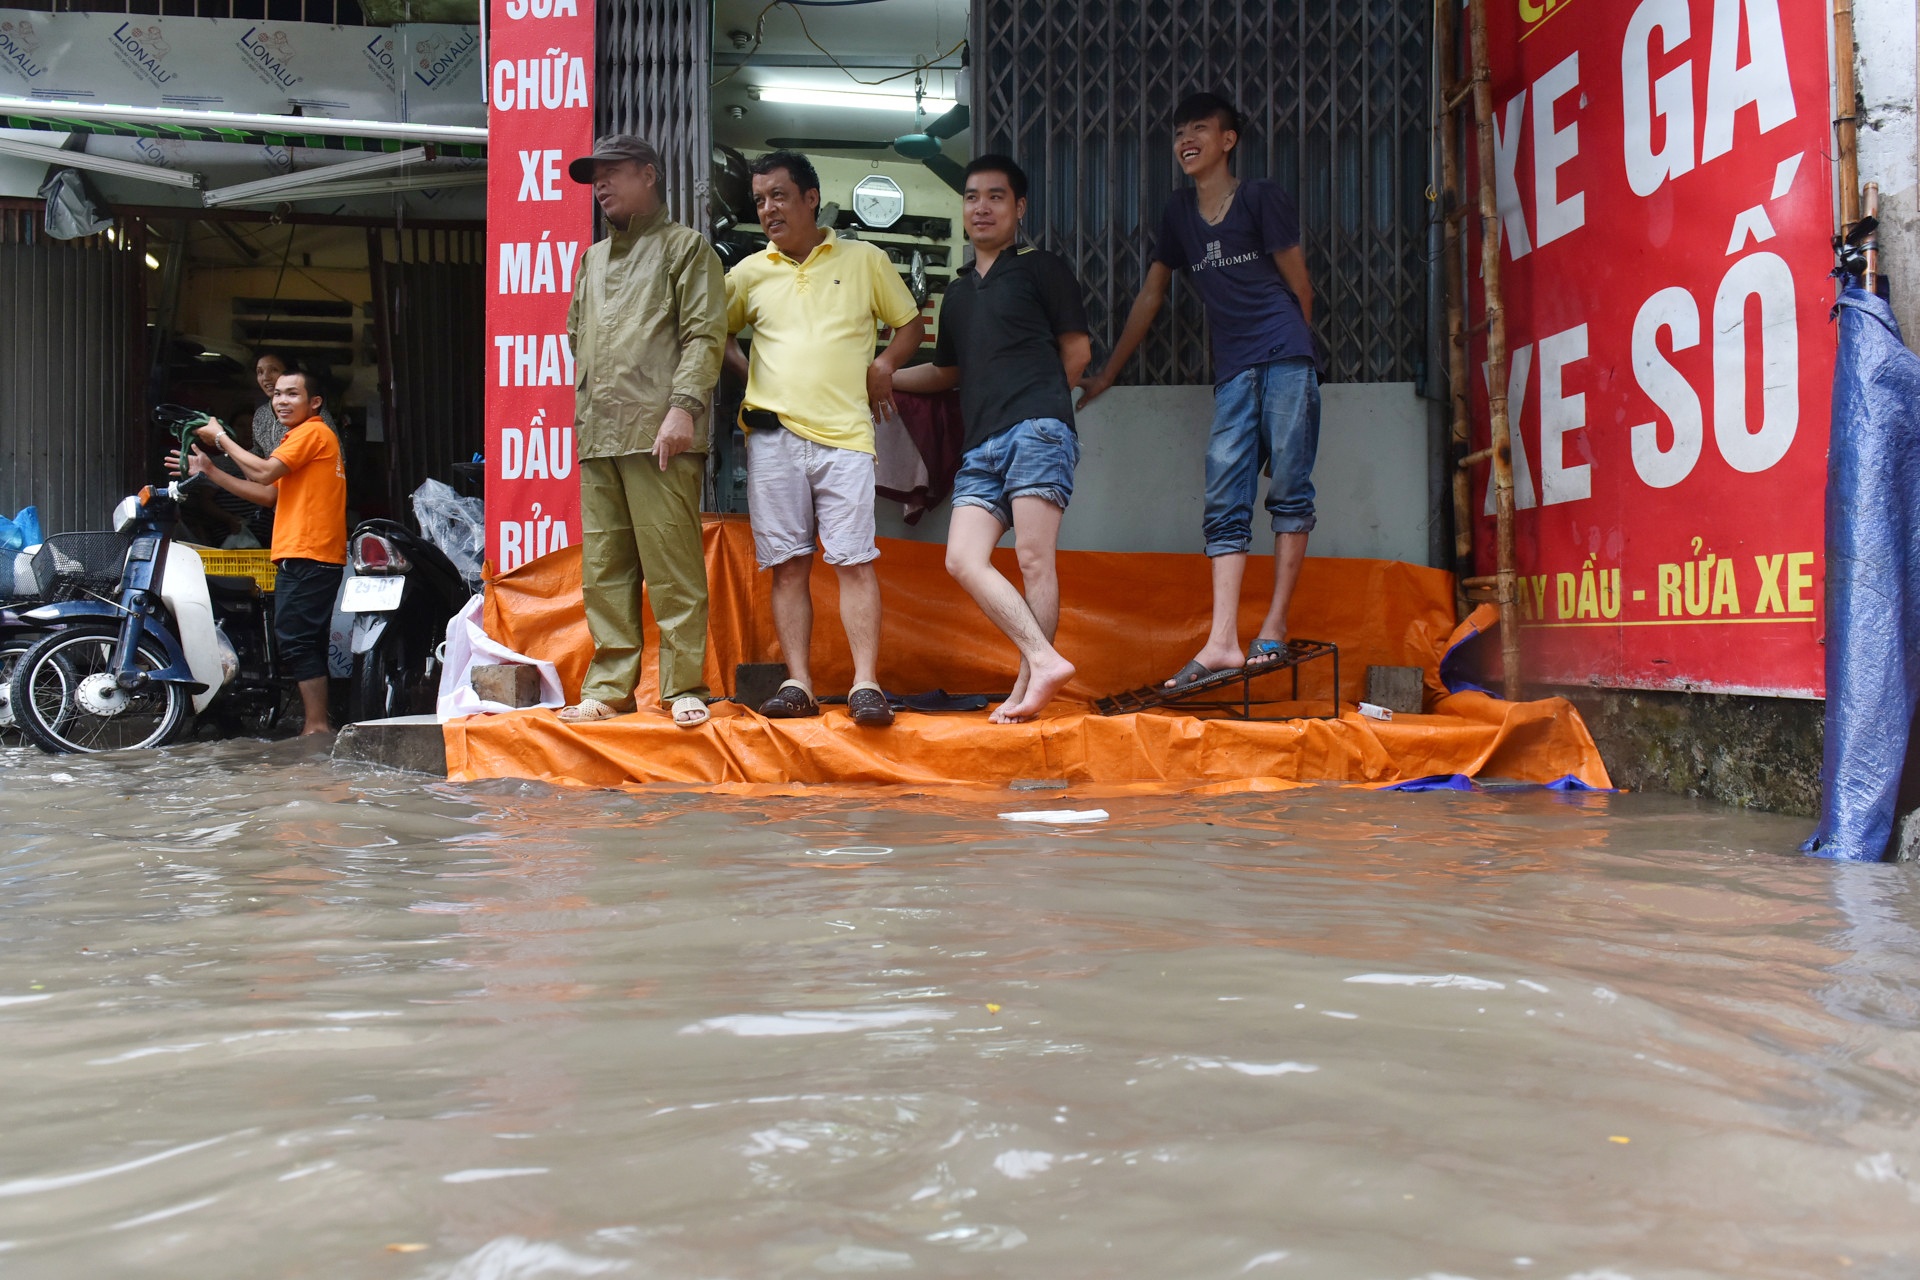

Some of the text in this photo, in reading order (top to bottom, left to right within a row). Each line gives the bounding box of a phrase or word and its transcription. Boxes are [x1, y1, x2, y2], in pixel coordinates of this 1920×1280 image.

[493, 47, 589, 111] CHỮA
[517, 149, 562, 202] XE
[1479, 50, 1585, 278] XE
[498, 230, 578, 295] MÁY
[1218, 251, 1259, 267] HOMME
[495, 334, 575, 387] THAY
[1482, 151, 1804, 516] XE SỐ
[501, 408, 572, 480] DẦU
[1556, 552, 1621, 620] DẦU
[1658, 536, 1740, 617] RỬA
[1754, 551, 1814, 614] XE
